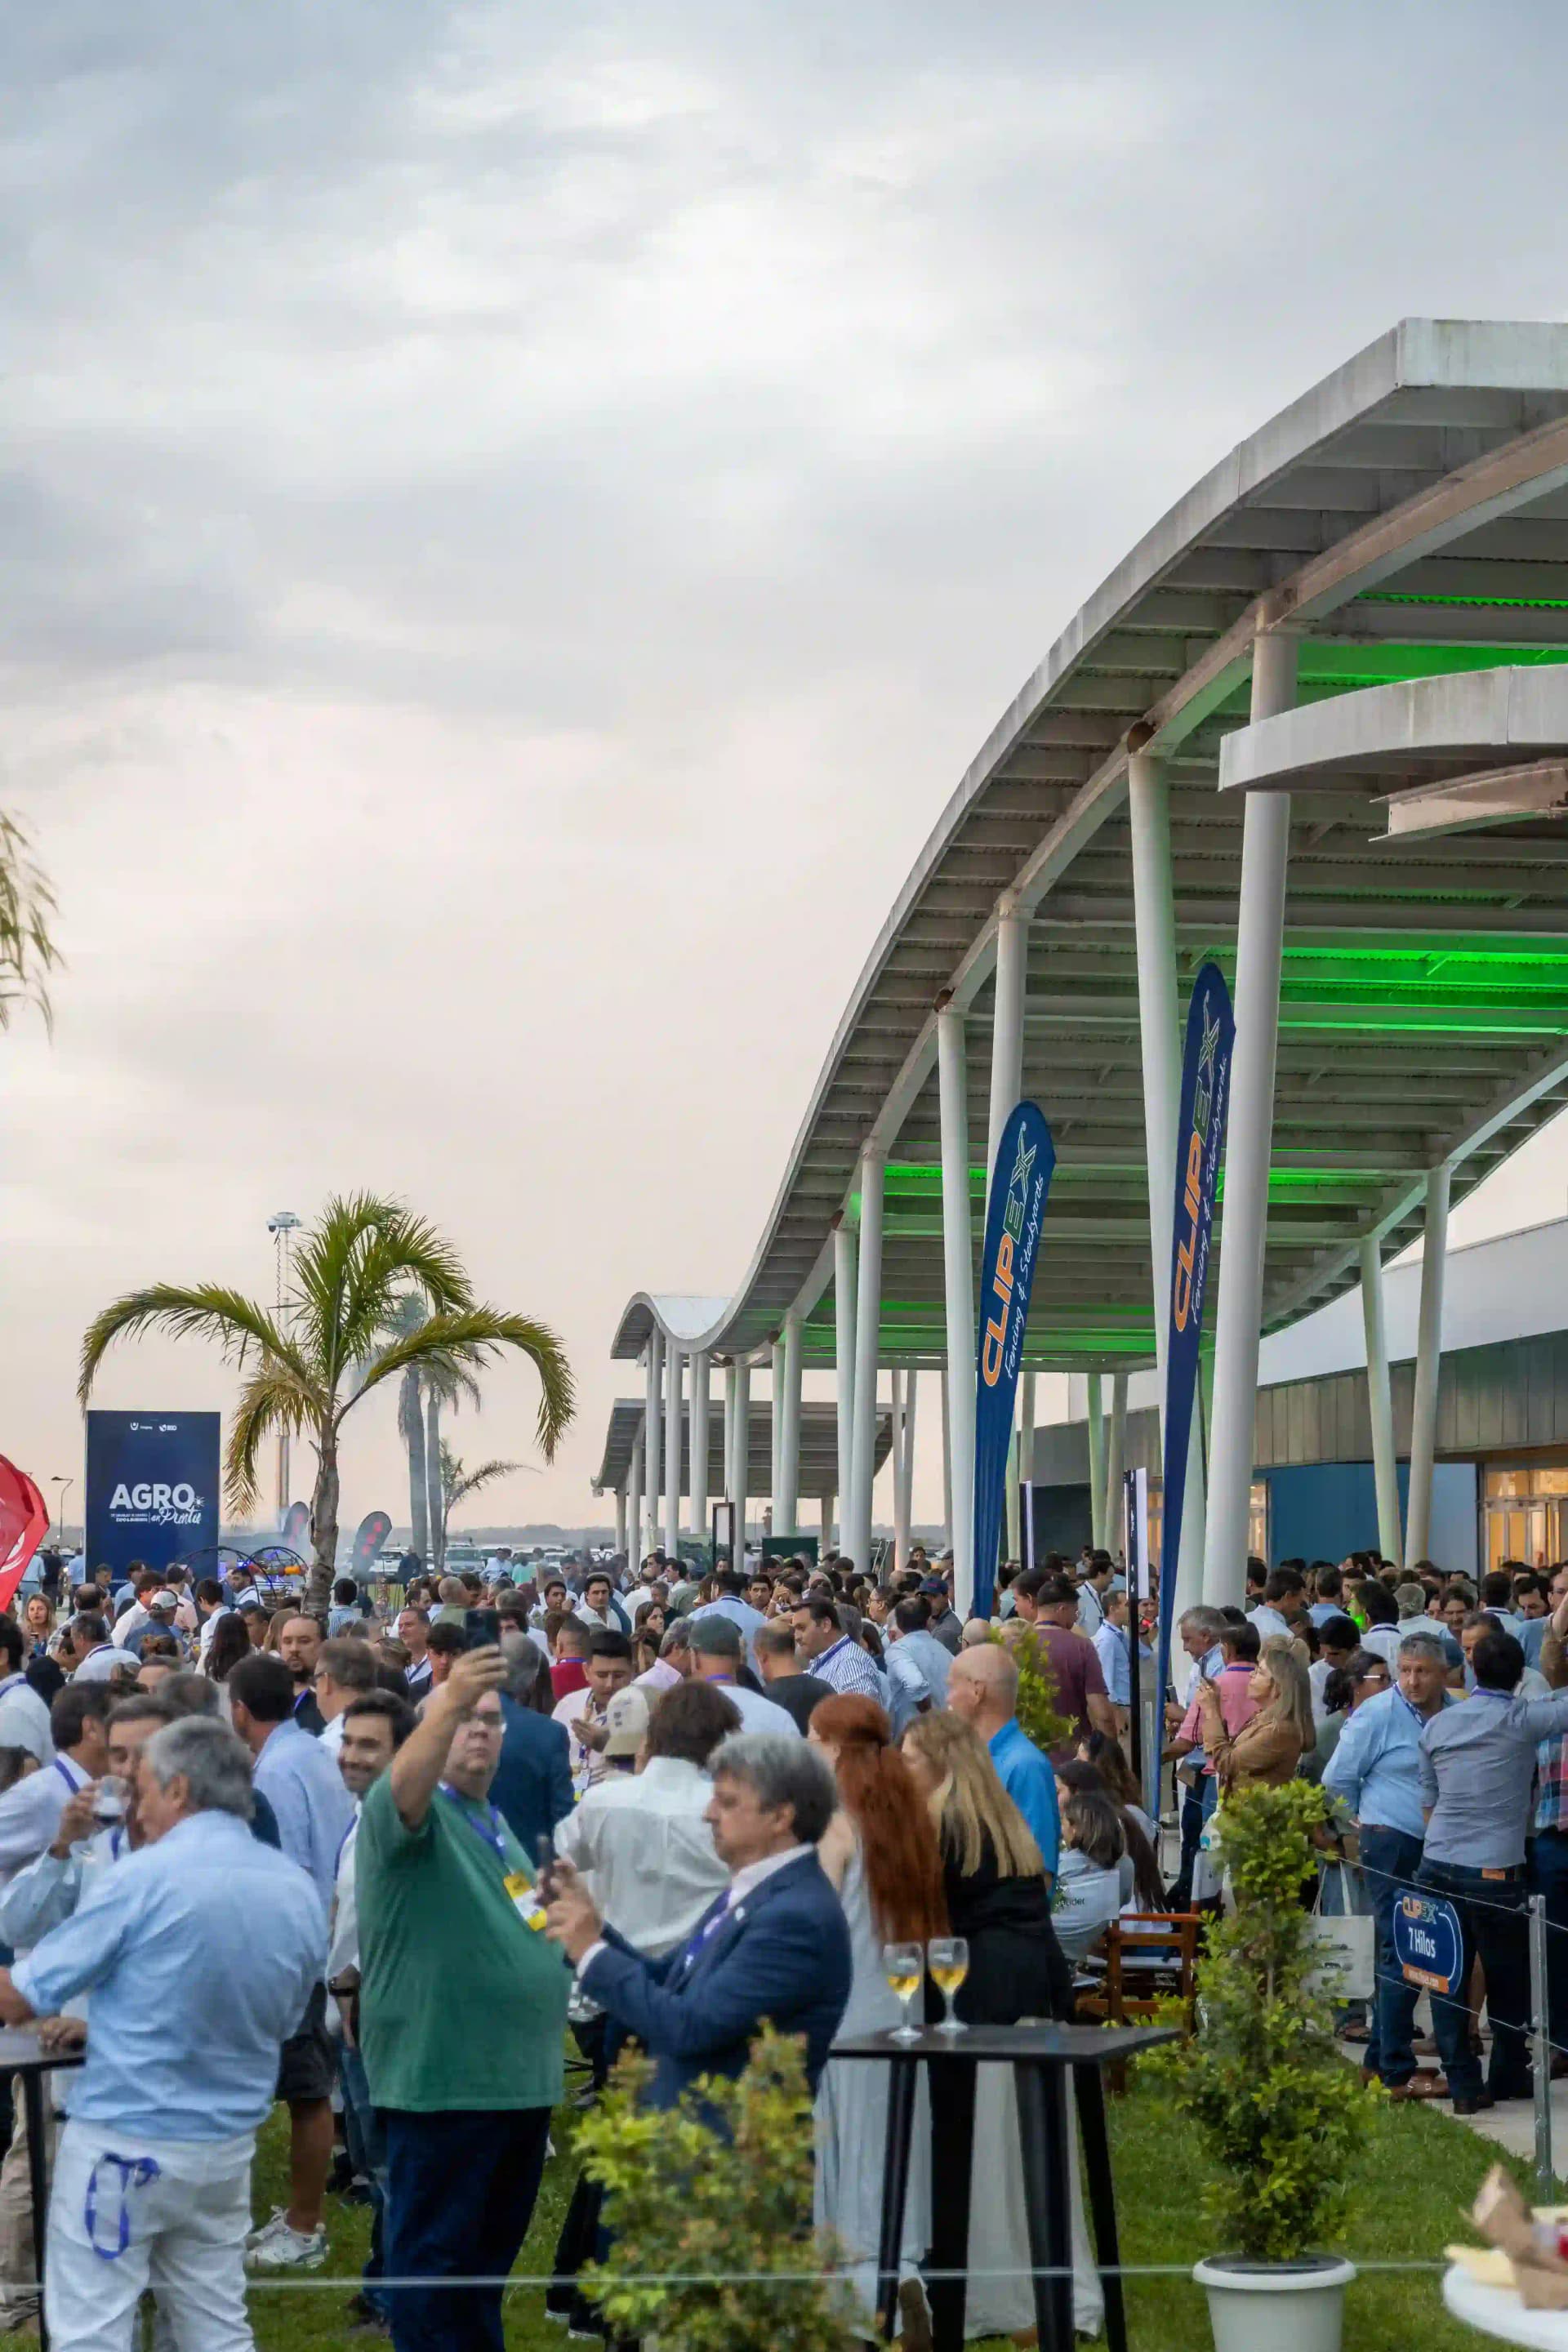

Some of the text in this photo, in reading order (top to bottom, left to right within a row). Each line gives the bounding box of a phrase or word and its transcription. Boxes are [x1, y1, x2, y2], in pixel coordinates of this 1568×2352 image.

[982, 1127, 1037, 1387] CLIPEX
[1174, 1000, 1221, 1333] CLIPEX
[1005, 1307, 1025, 1379] Fencing
[1020, 1173, 1044, 1282] Stockyards
[109, 1483, 195, 1510] AGRO
[1408, 1927, 1437, 1958] 7 Hilos
